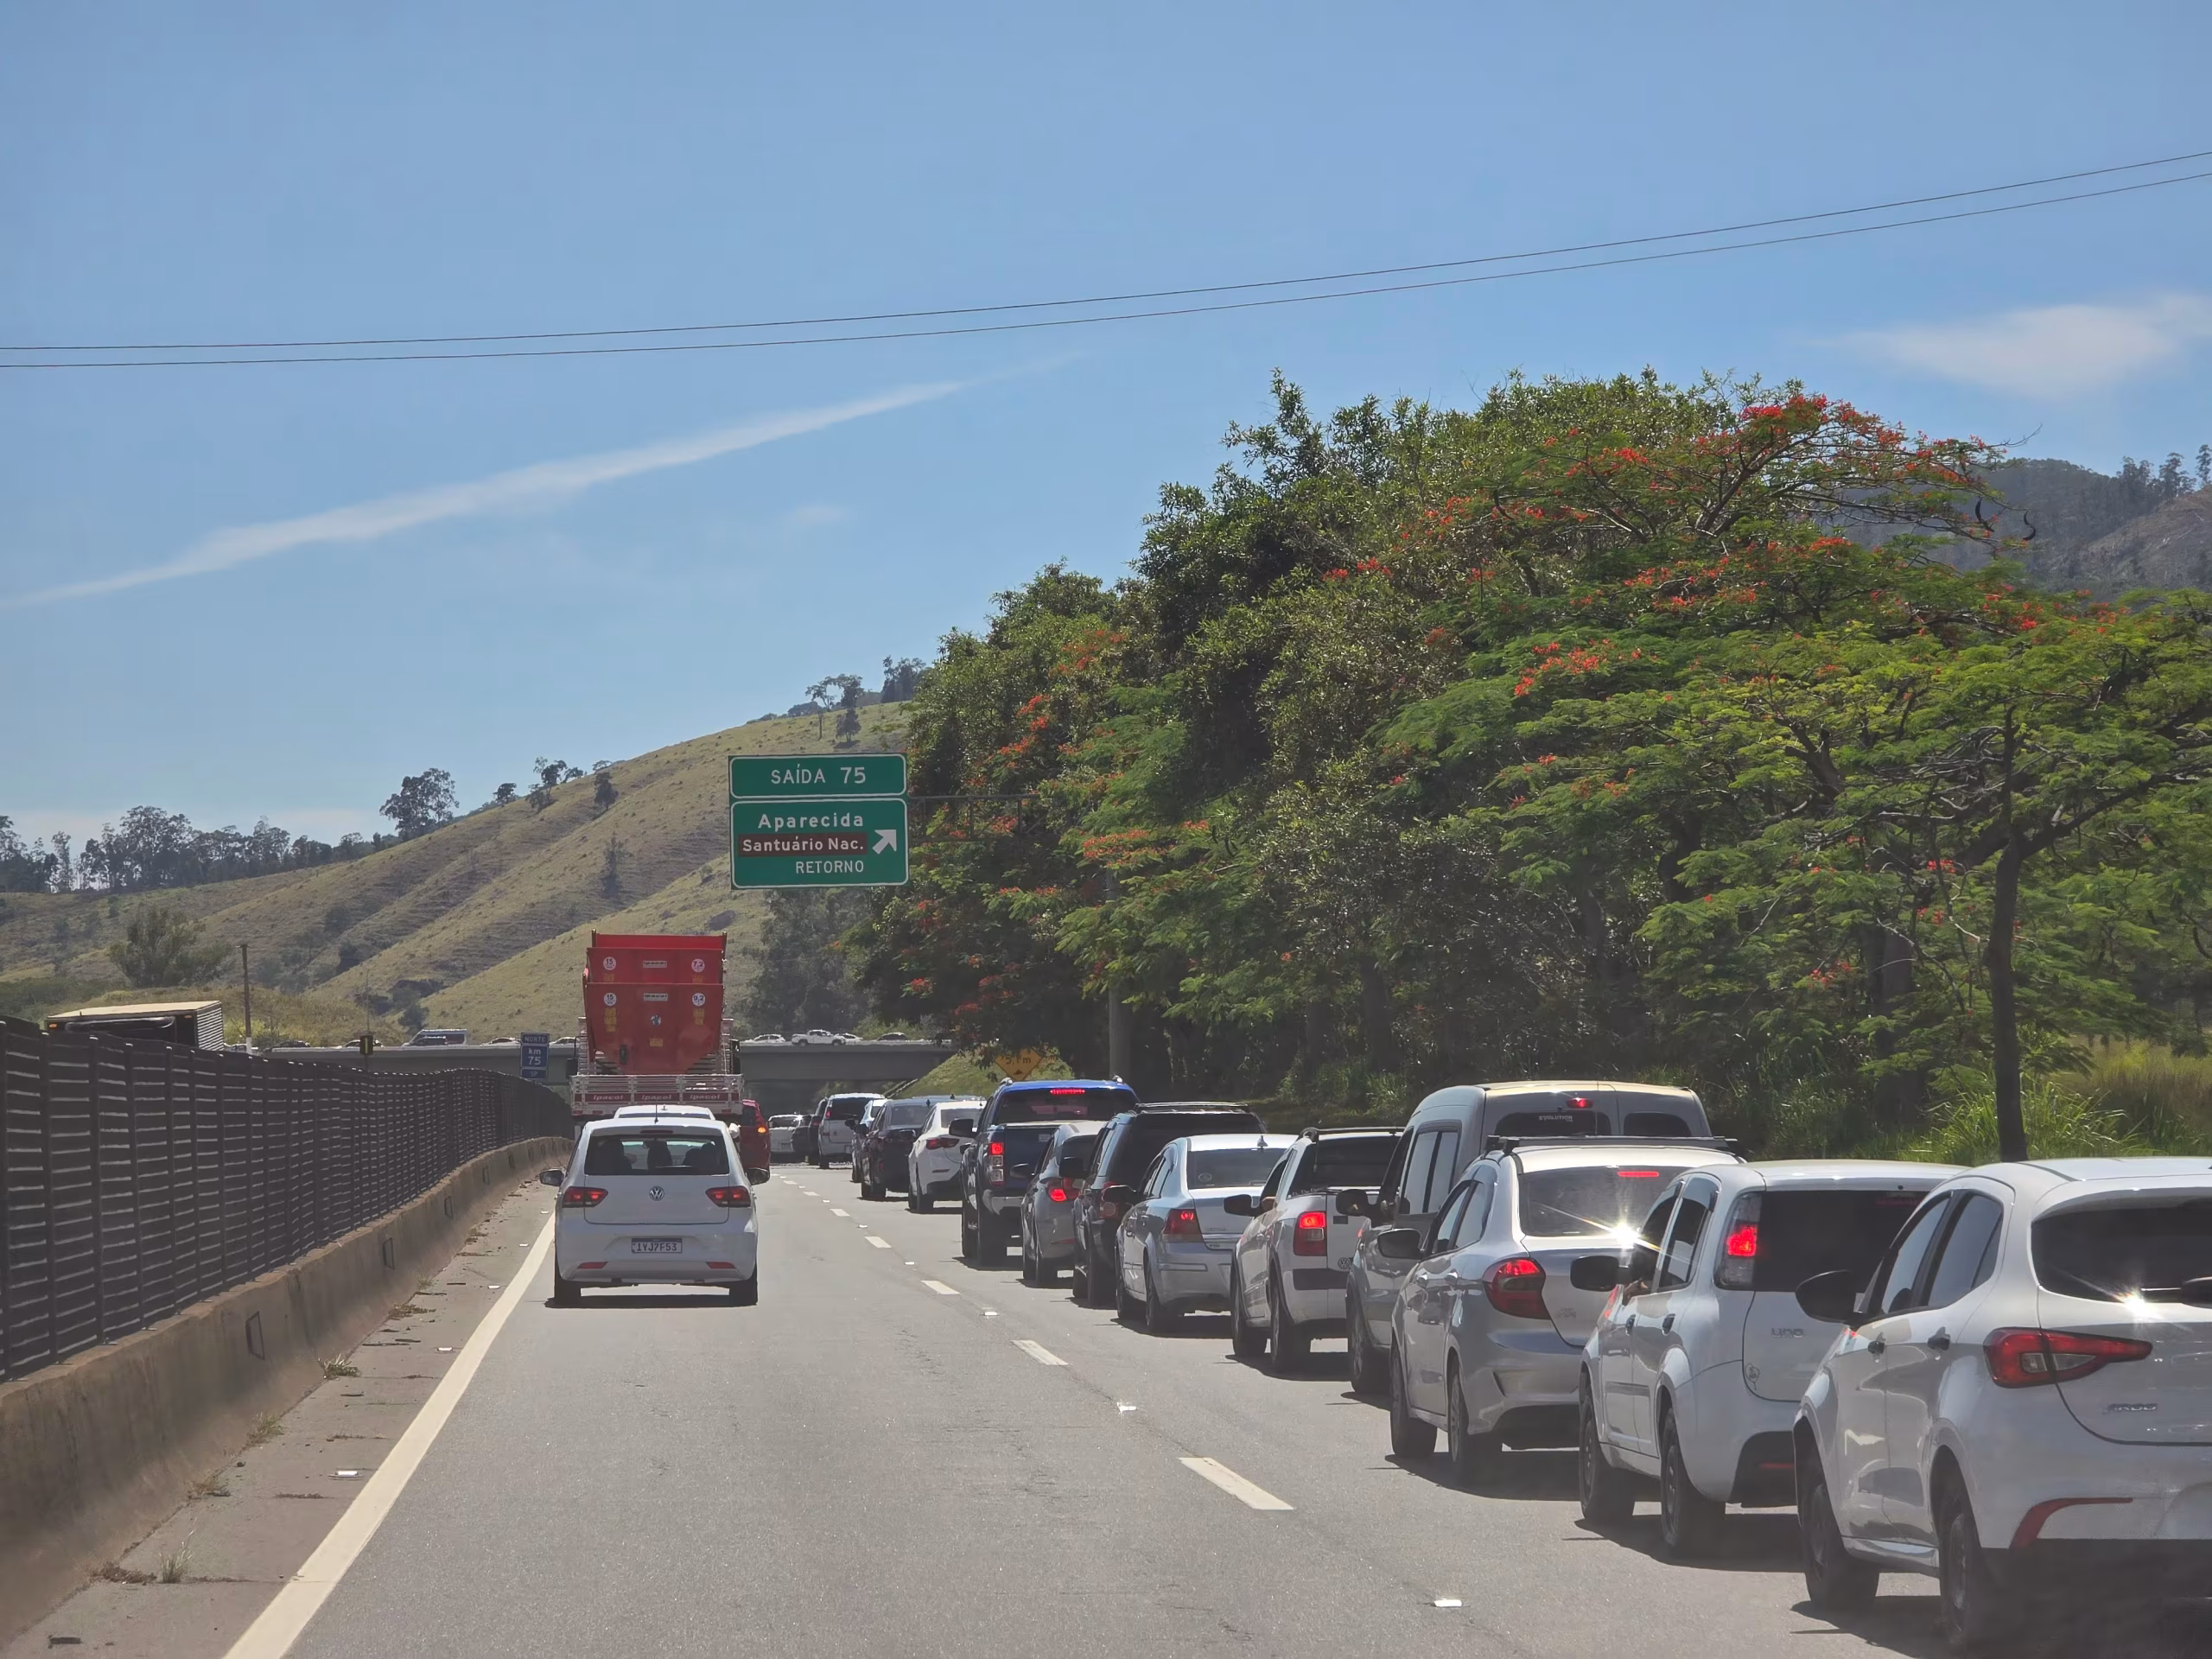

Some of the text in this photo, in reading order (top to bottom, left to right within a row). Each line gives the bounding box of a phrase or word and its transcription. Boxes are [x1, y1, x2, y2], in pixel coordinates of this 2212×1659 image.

[771, 764, 867, 784] SAÍDA 75
[758, 812, 864, 832] Aparecida
[742, 836, 864, 852] Santuário Nac.
[796, 860, 864, 874] RETORNO
[527, 1056, 541, 1065] 75
